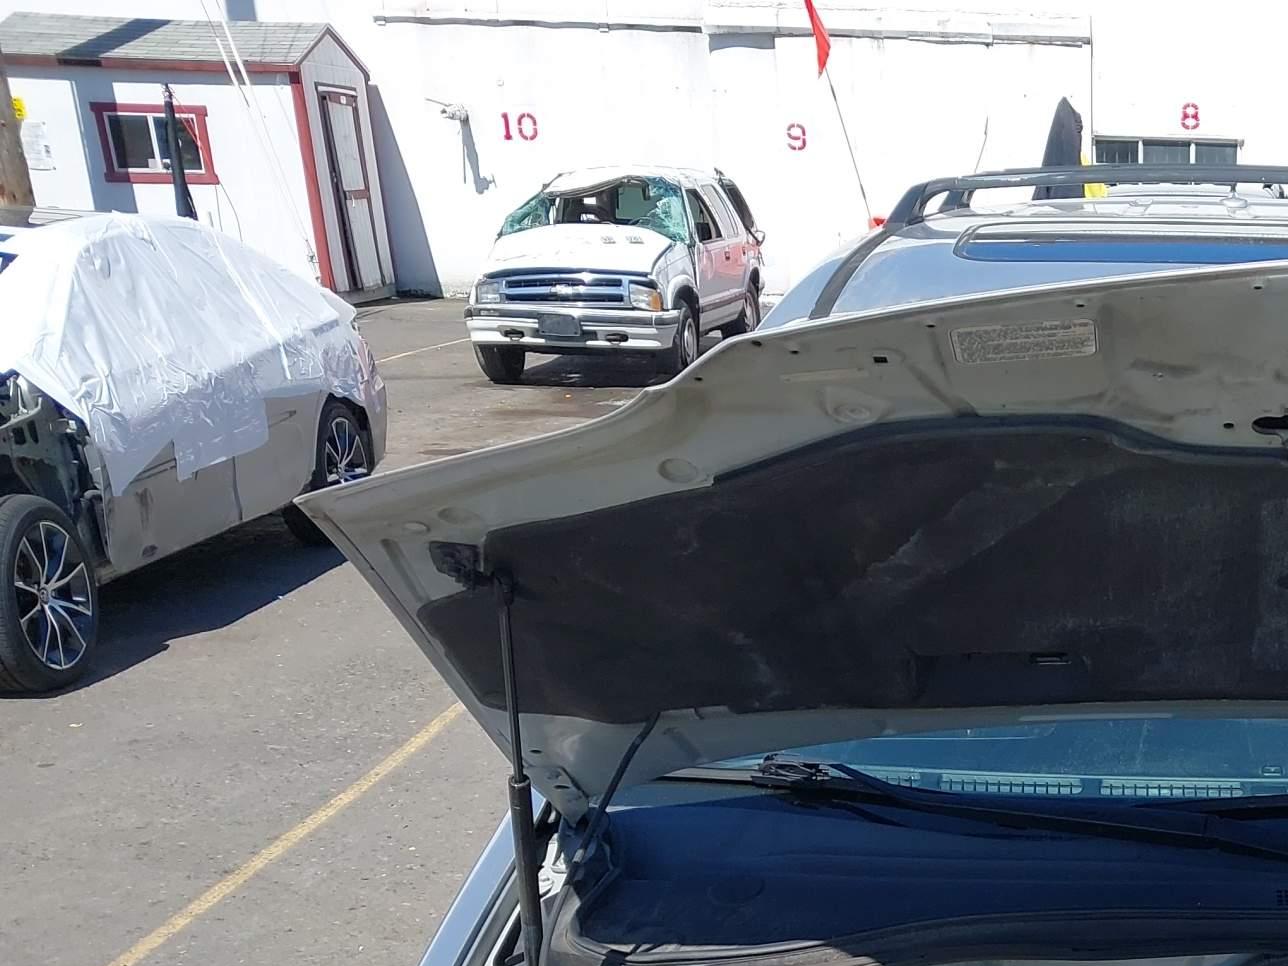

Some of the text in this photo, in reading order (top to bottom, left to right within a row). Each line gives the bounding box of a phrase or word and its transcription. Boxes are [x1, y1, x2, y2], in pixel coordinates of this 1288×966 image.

[501, 112, 538, 141] 10
[1181, 103, 1200, 130] 8
[787, 123, 807, 151] 9
